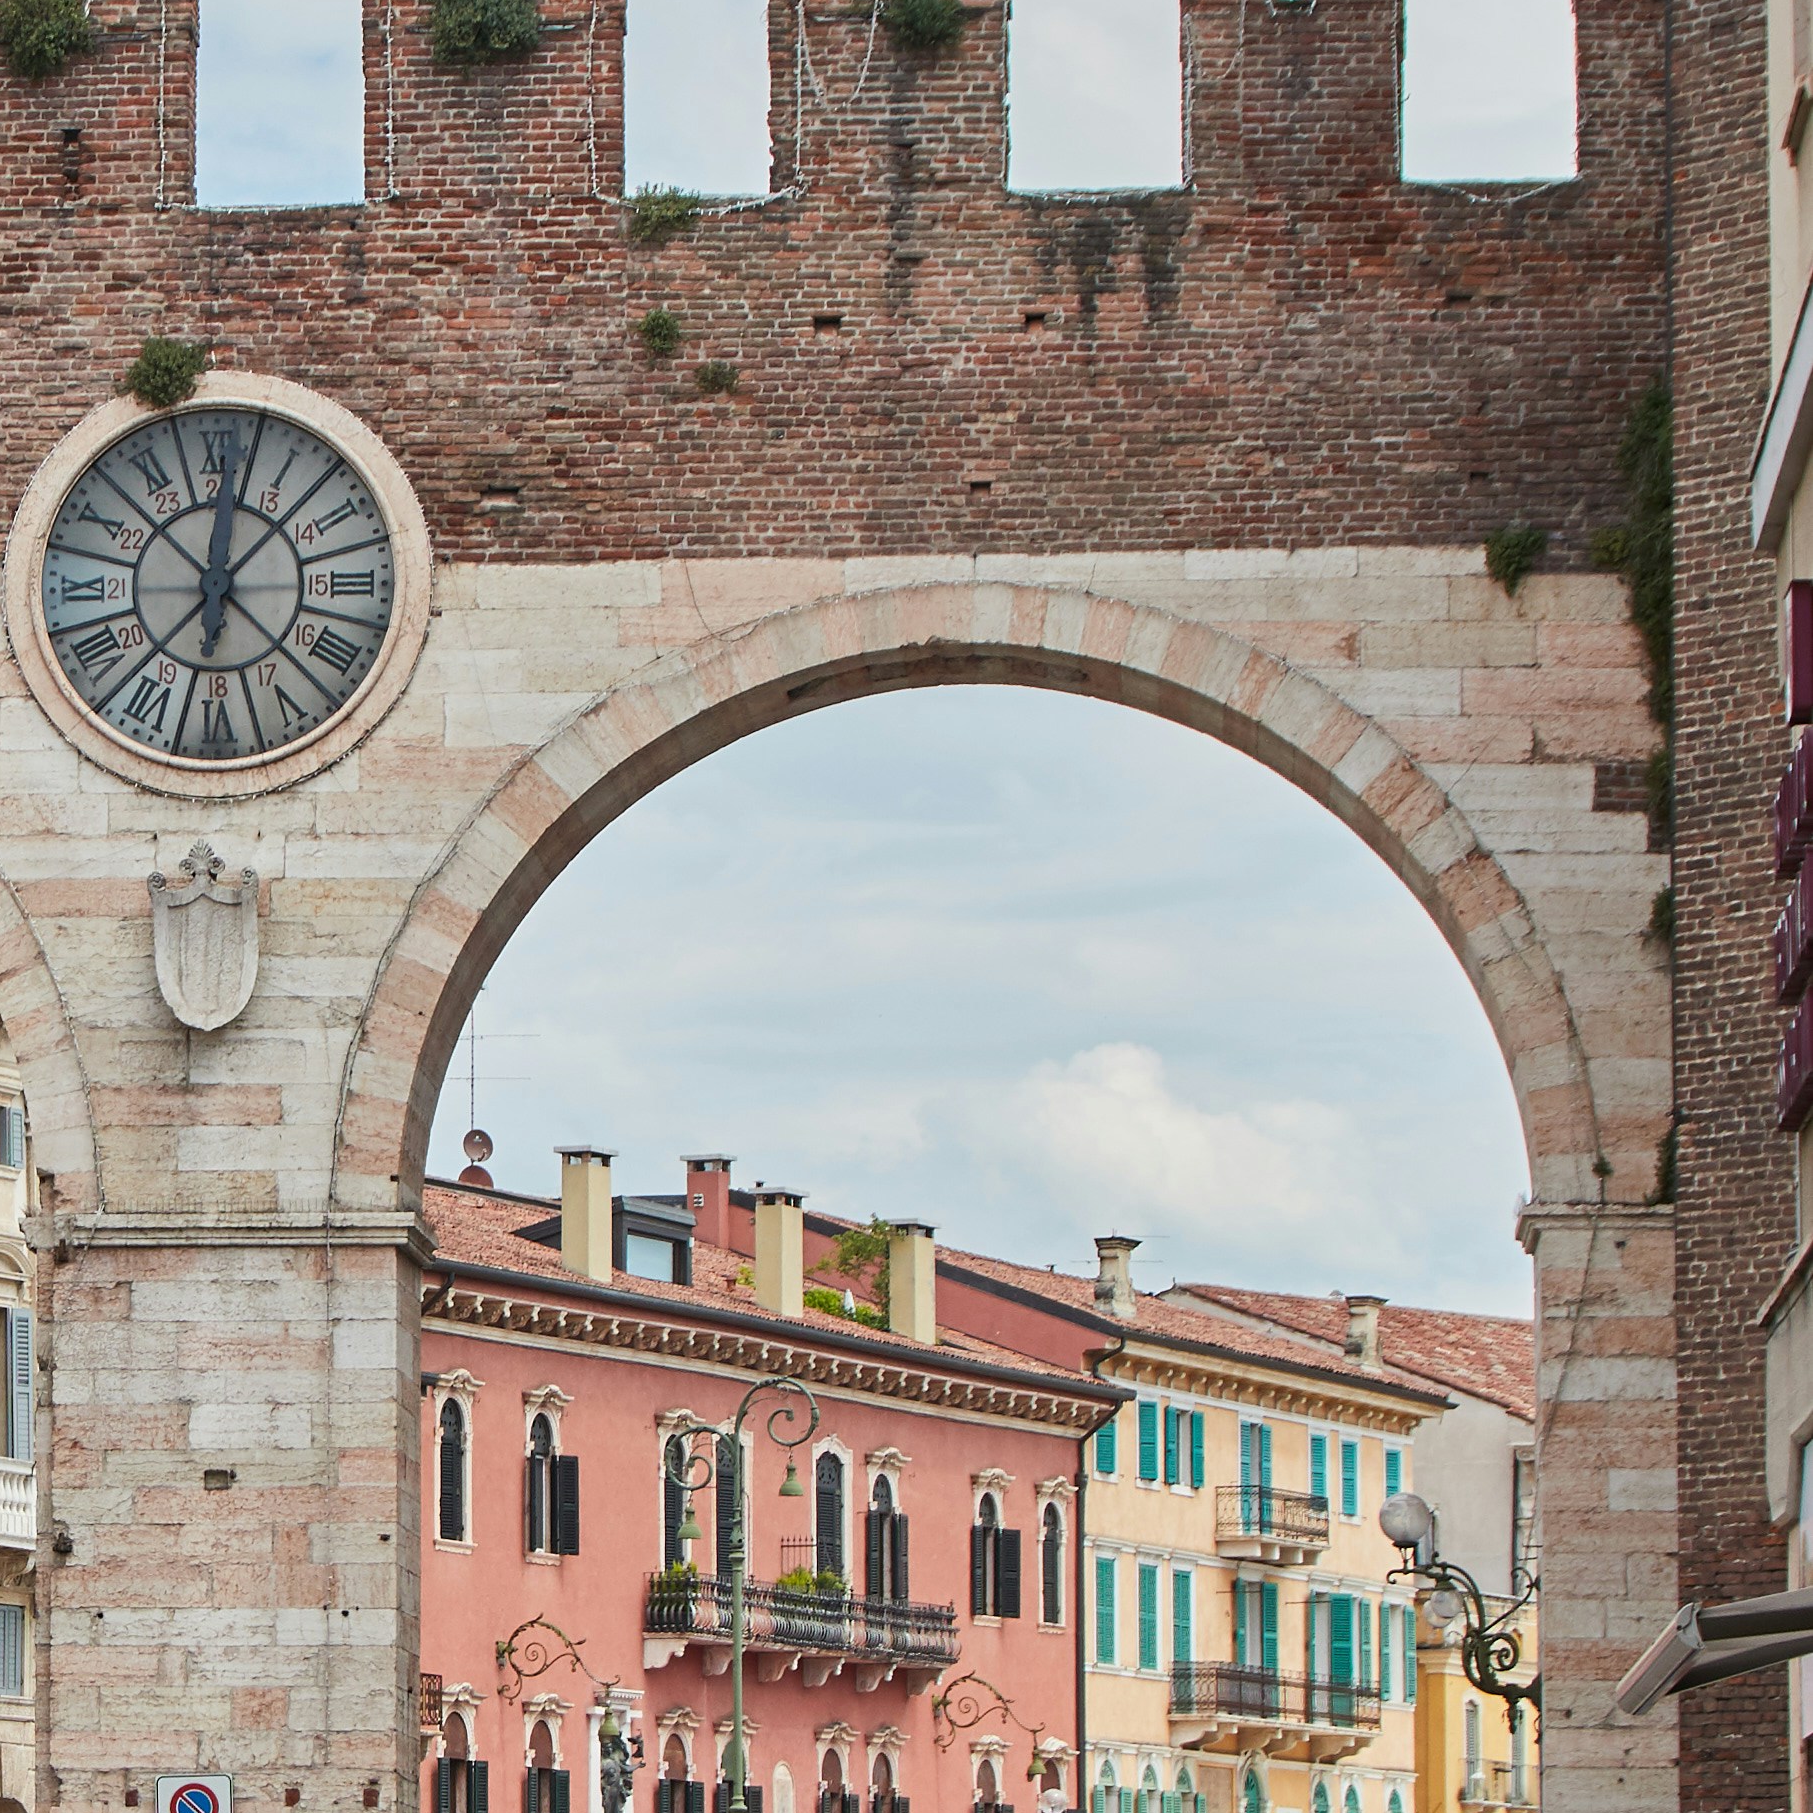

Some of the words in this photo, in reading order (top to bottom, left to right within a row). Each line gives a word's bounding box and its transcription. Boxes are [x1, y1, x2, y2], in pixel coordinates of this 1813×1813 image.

[129, 447, 173, 496] XI
[270, 448, 299, 490] I
[156, 490, 181, 515] 23
[260, 490, 279, 513] 13
[78, 500, 124, 540] X
[312, 498, 358, 536] II
[120, 529, 144, 550] 22
[295, 522, 315, 546] 14
[107, 578, 126, 599] 21
[308, 574, 328, 596] 15
[330, 569, 375, 598] III
[119, 624, 144, 650] 20
[295, 624, 315, 647] 16
[158, 661, 177, 685] 19
[258, 662, 278, 687] 17
[208, 675, 228, 698] 18
[274, 684, 308, 728] V
